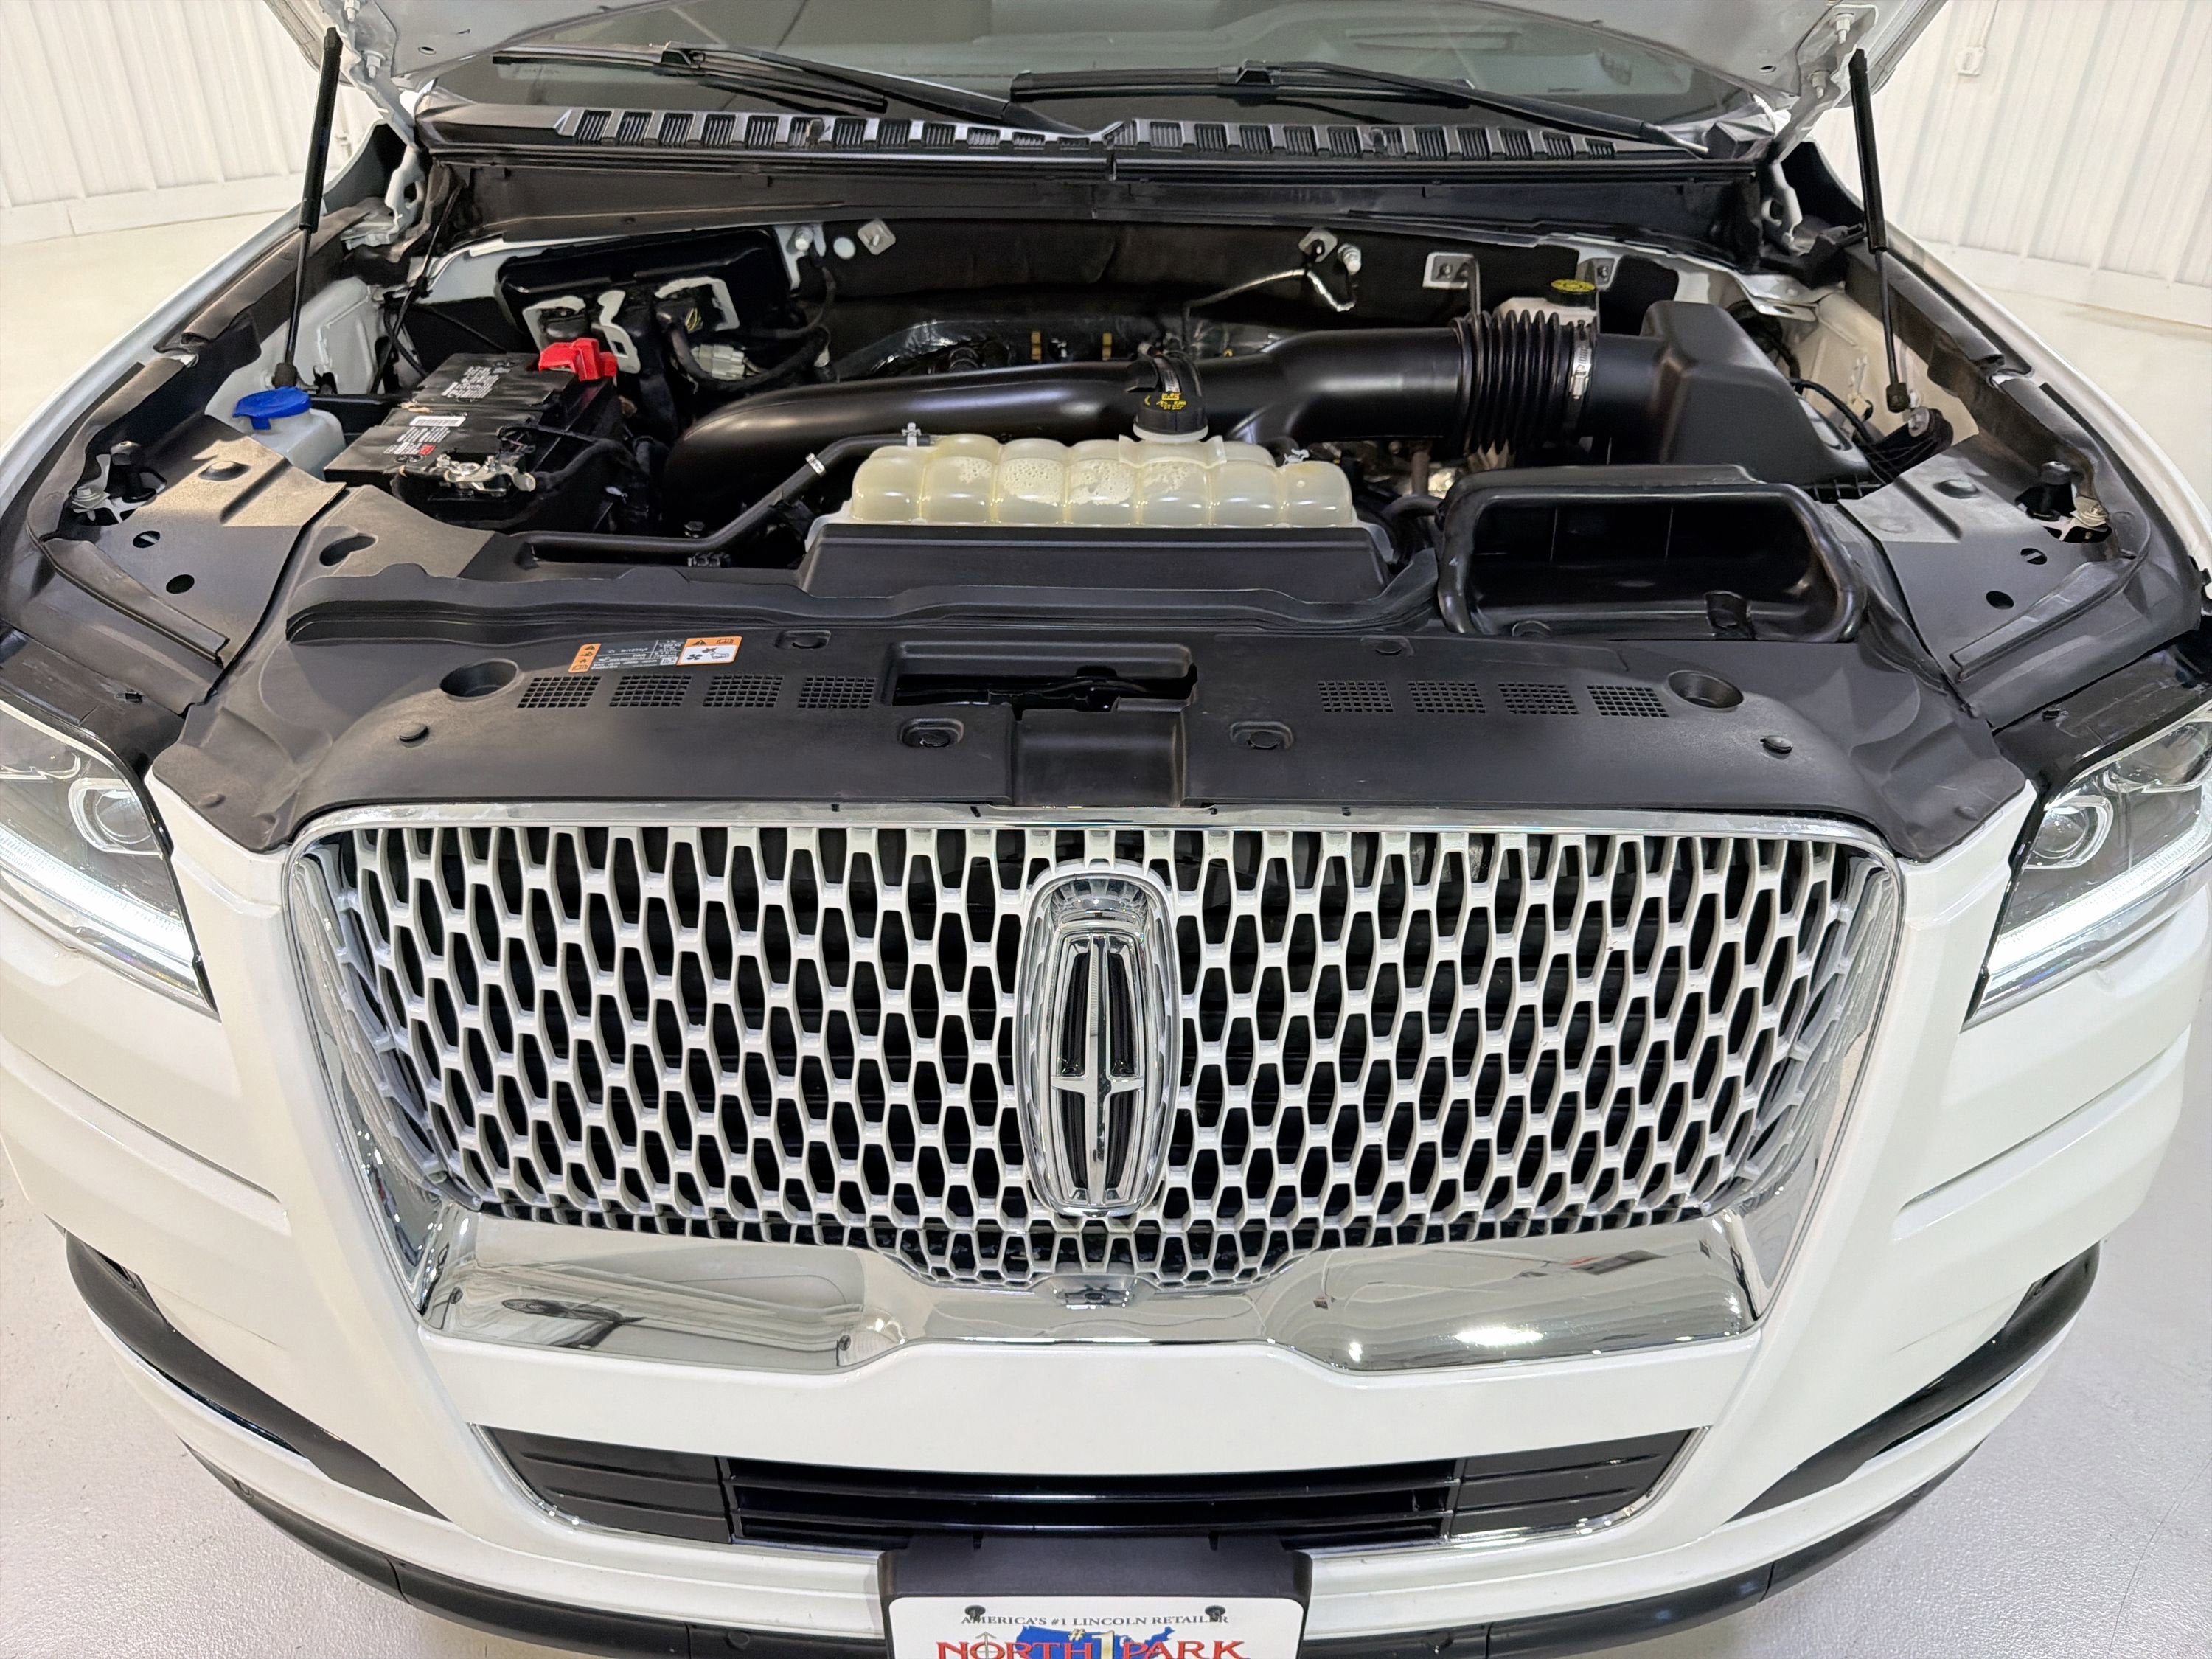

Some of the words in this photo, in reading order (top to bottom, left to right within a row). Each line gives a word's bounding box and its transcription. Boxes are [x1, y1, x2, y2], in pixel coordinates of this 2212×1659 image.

[1051, 1617, 1067, 1626] #1
[1073, 1616, 1147, 1626] LINCOLN
[1151, 1615, 1229, 1625] RETAILR
[936, 1641, 1093, 1659] NORTH
[1122, 1640, 1251, 1659] PARK
